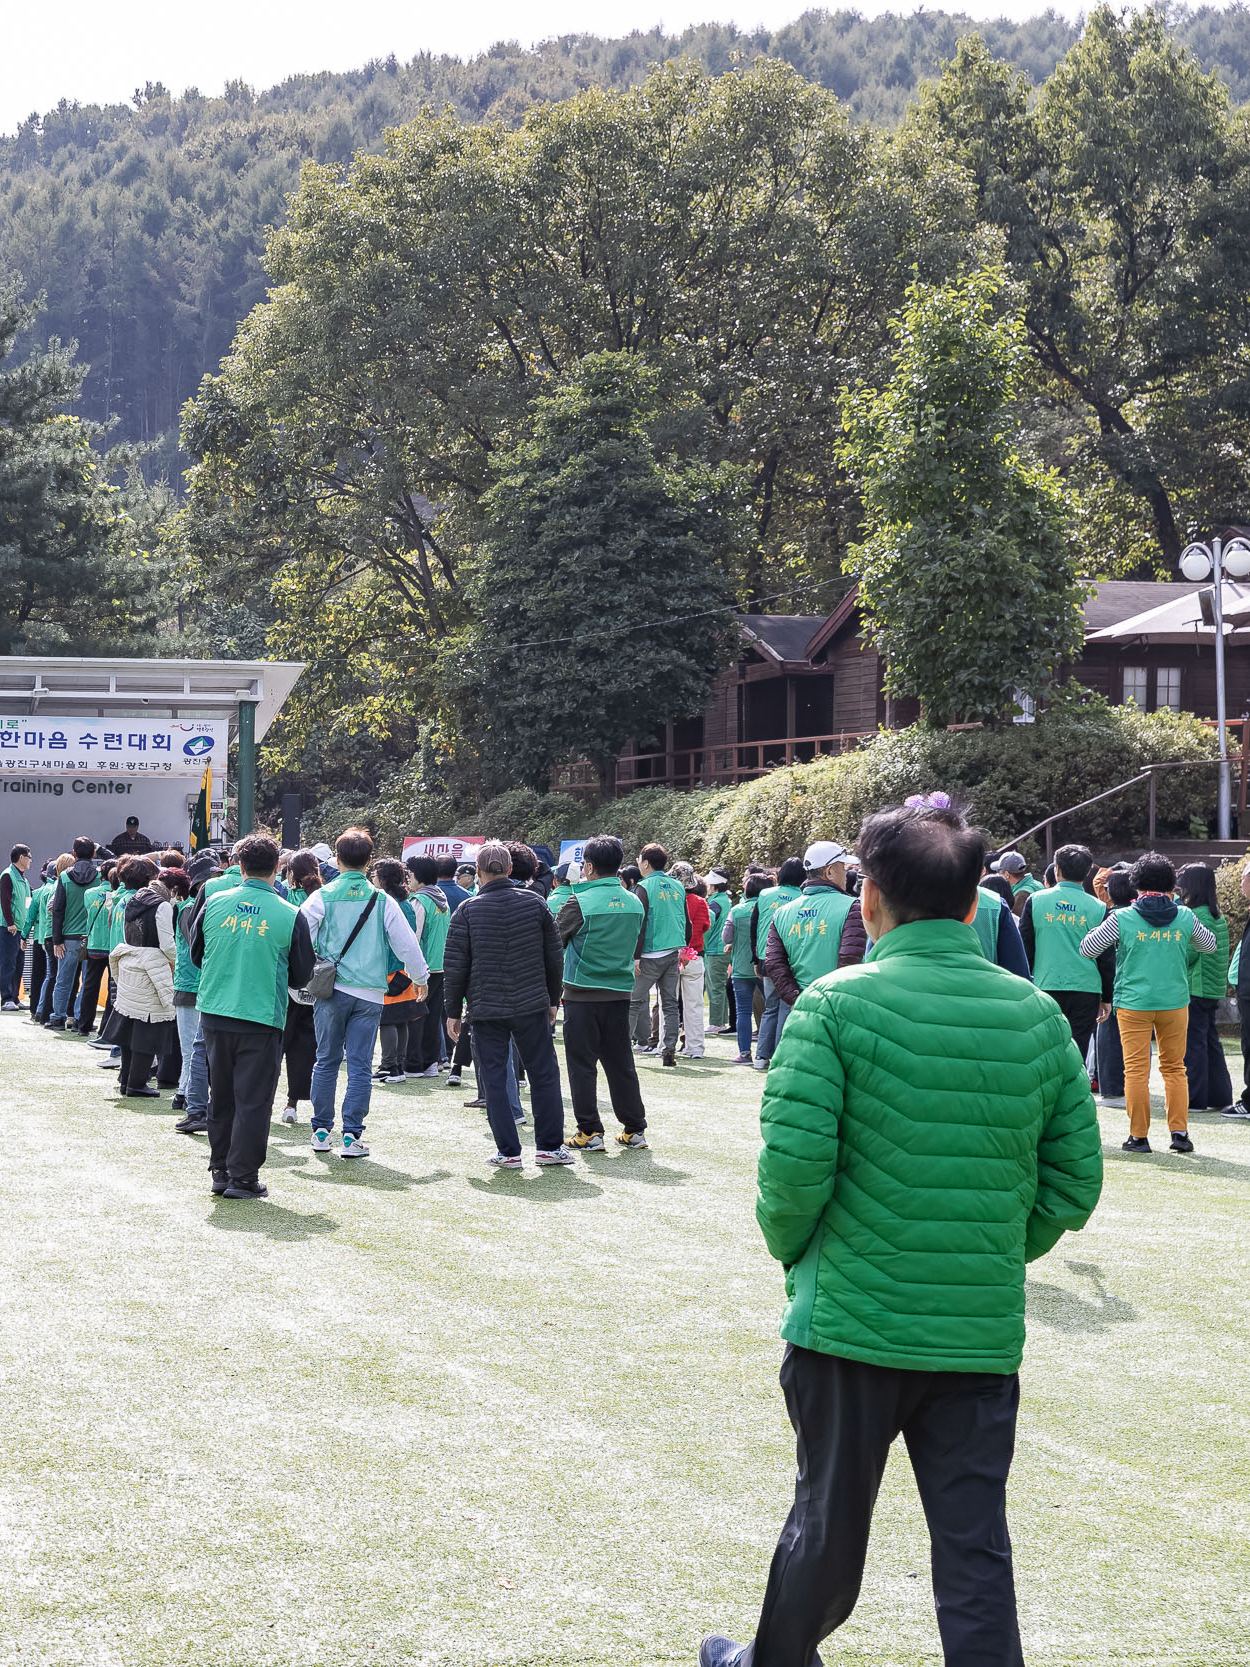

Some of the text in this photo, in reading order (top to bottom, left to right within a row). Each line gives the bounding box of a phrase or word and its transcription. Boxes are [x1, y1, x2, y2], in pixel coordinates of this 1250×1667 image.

[0, 731, 68, 749] 한마음
[78, 732, 172, 752] 수련대회
[96, 761, 173, 771] 후원:광진구청
[71, 779, 133, 795] Center
[236, 902, 261, 915] SMU
[797, 908, 818, 919] SMU
[1055, 902, 1077, 912] SMU
[220, 915, 270, 937] 새마을
[788, 919, 829, 939] 새마을
